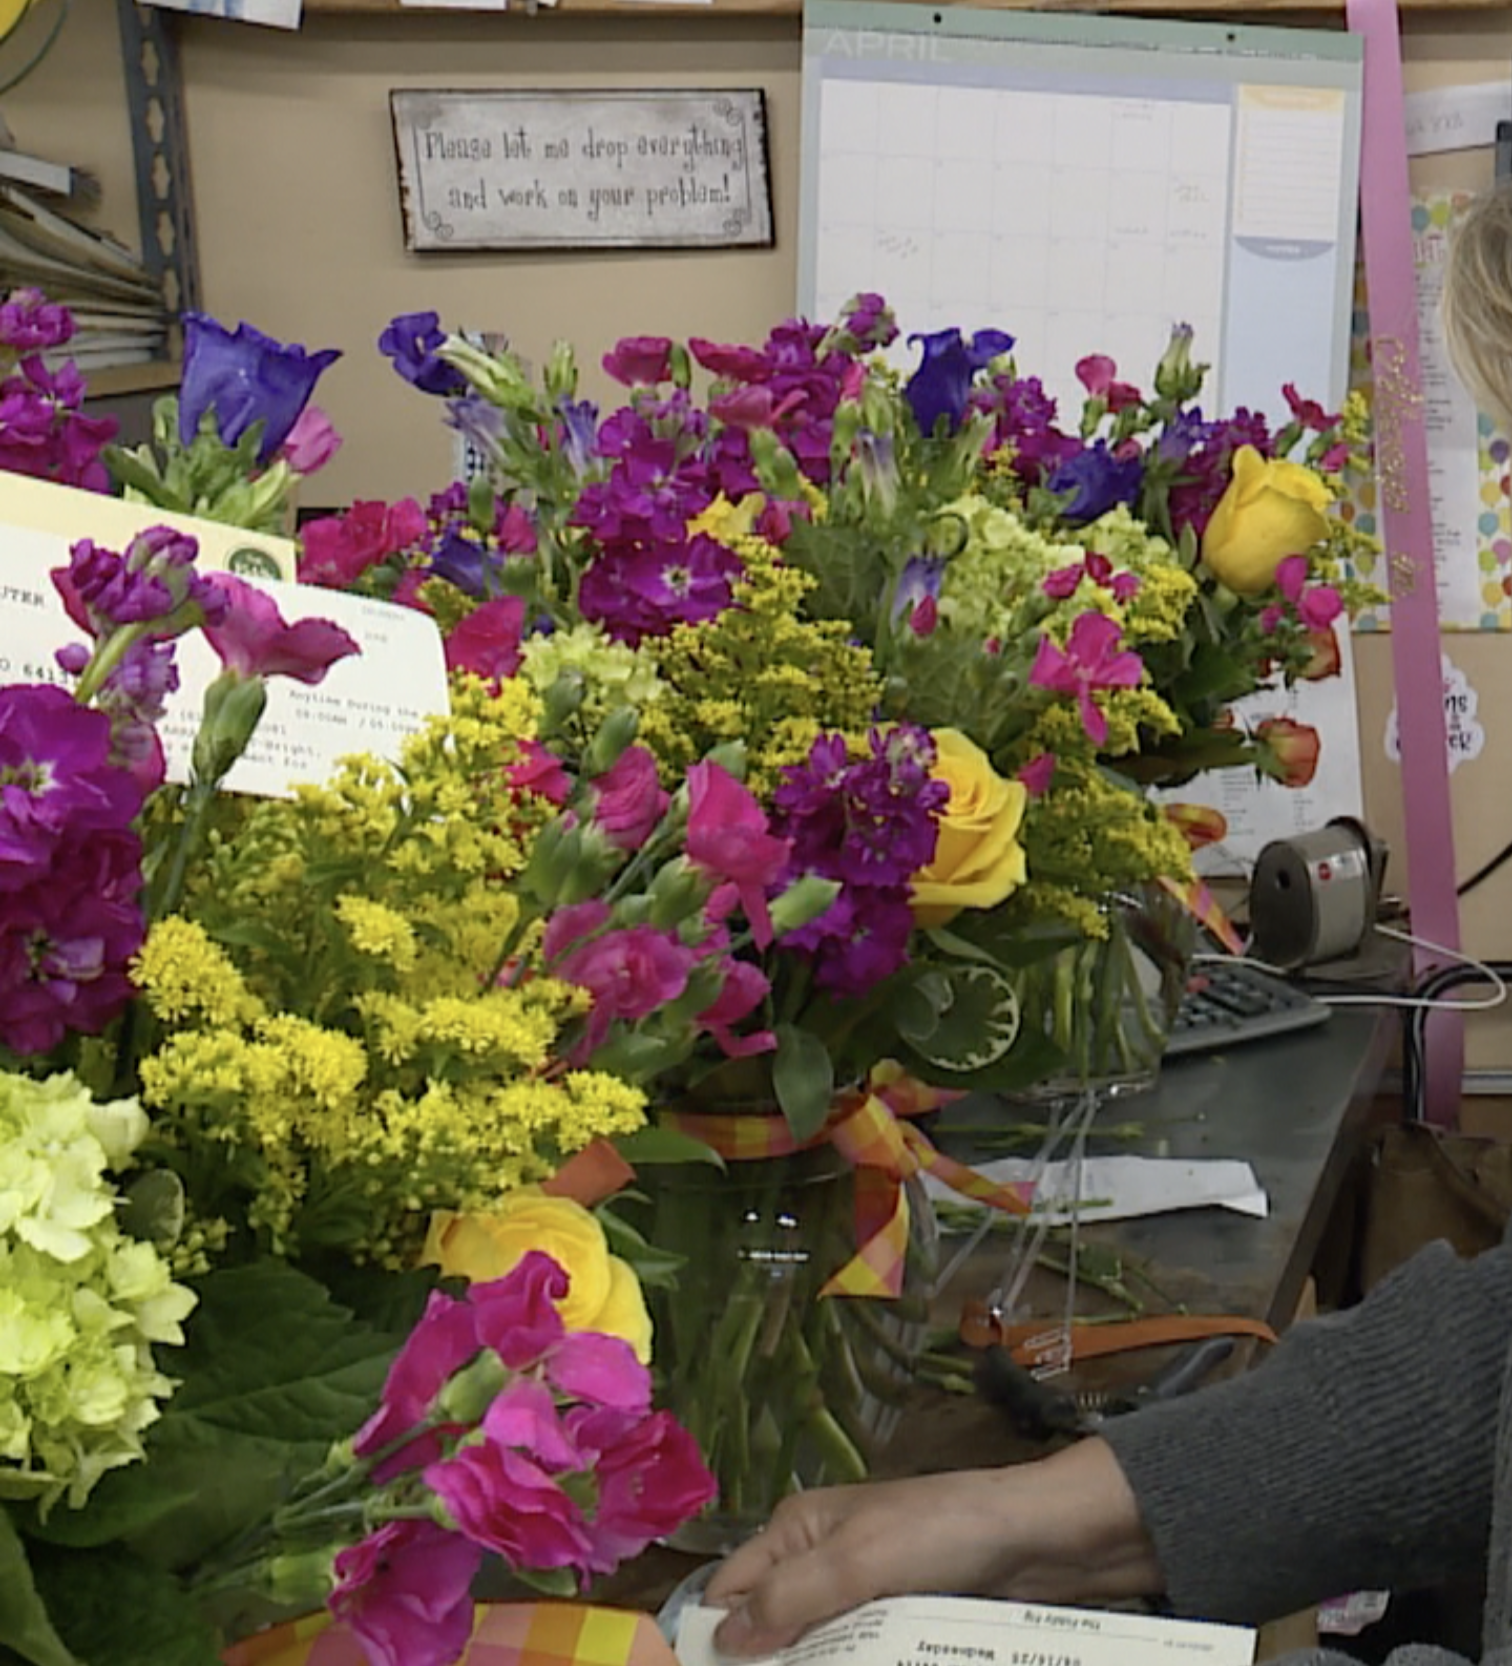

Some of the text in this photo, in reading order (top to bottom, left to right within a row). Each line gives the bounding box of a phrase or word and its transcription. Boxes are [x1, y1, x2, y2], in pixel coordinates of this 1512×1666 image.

[824, 29, 953, 63] APRIL
[425, 122, 743, 173] Please let me drop everything
[448, 173, 731, 222] and work on your problem!
[916, 1640, 995, 1661] Wednesday
